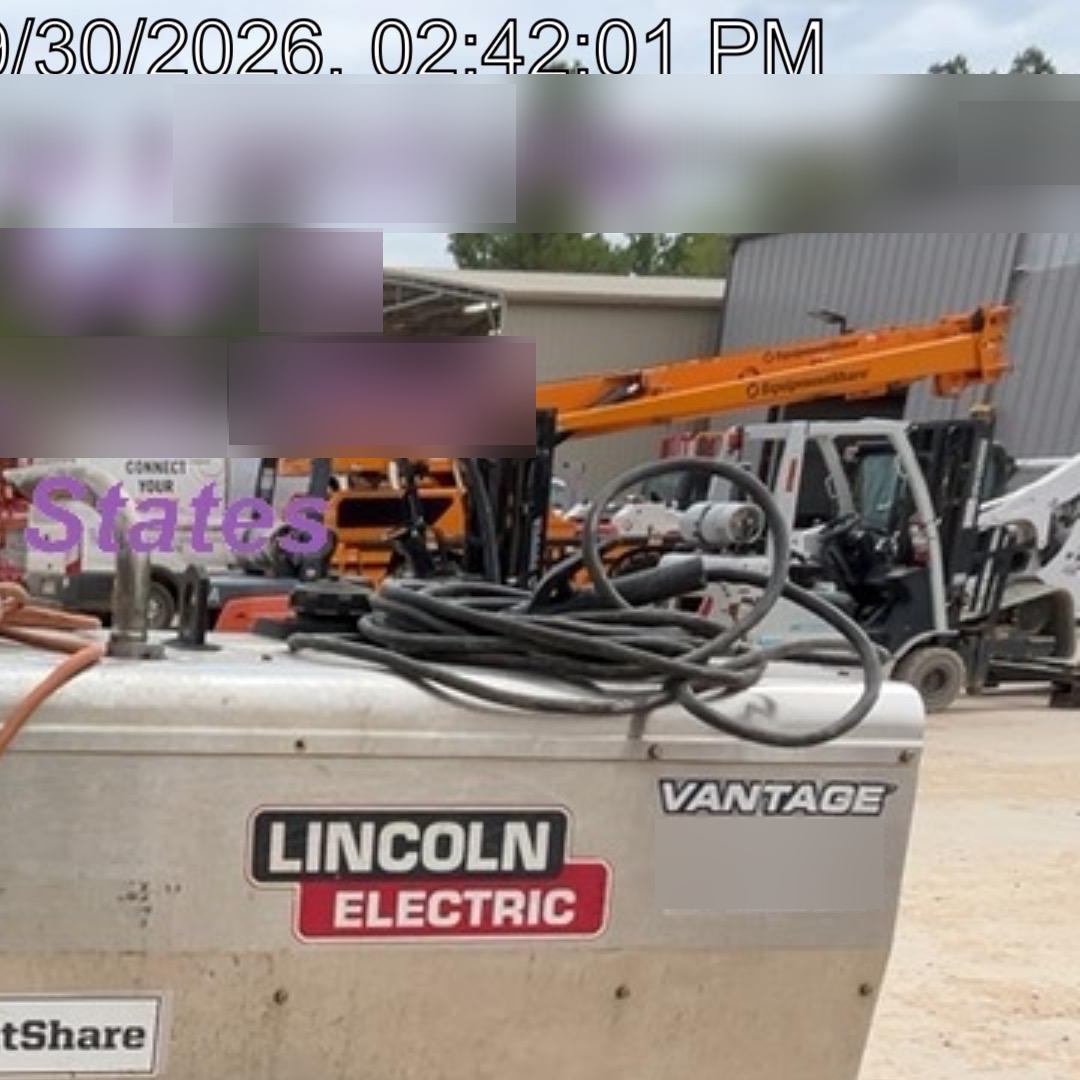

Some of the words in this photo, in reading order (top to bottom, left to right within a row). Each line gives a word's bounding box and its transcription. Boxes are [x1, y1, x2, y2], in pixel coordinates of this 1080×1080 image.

[660, 779, 887, 816] VANTAGE
[267, 820, 552, 873] LINCOLN
[332, 887, 577, 930] ELECTRIC
